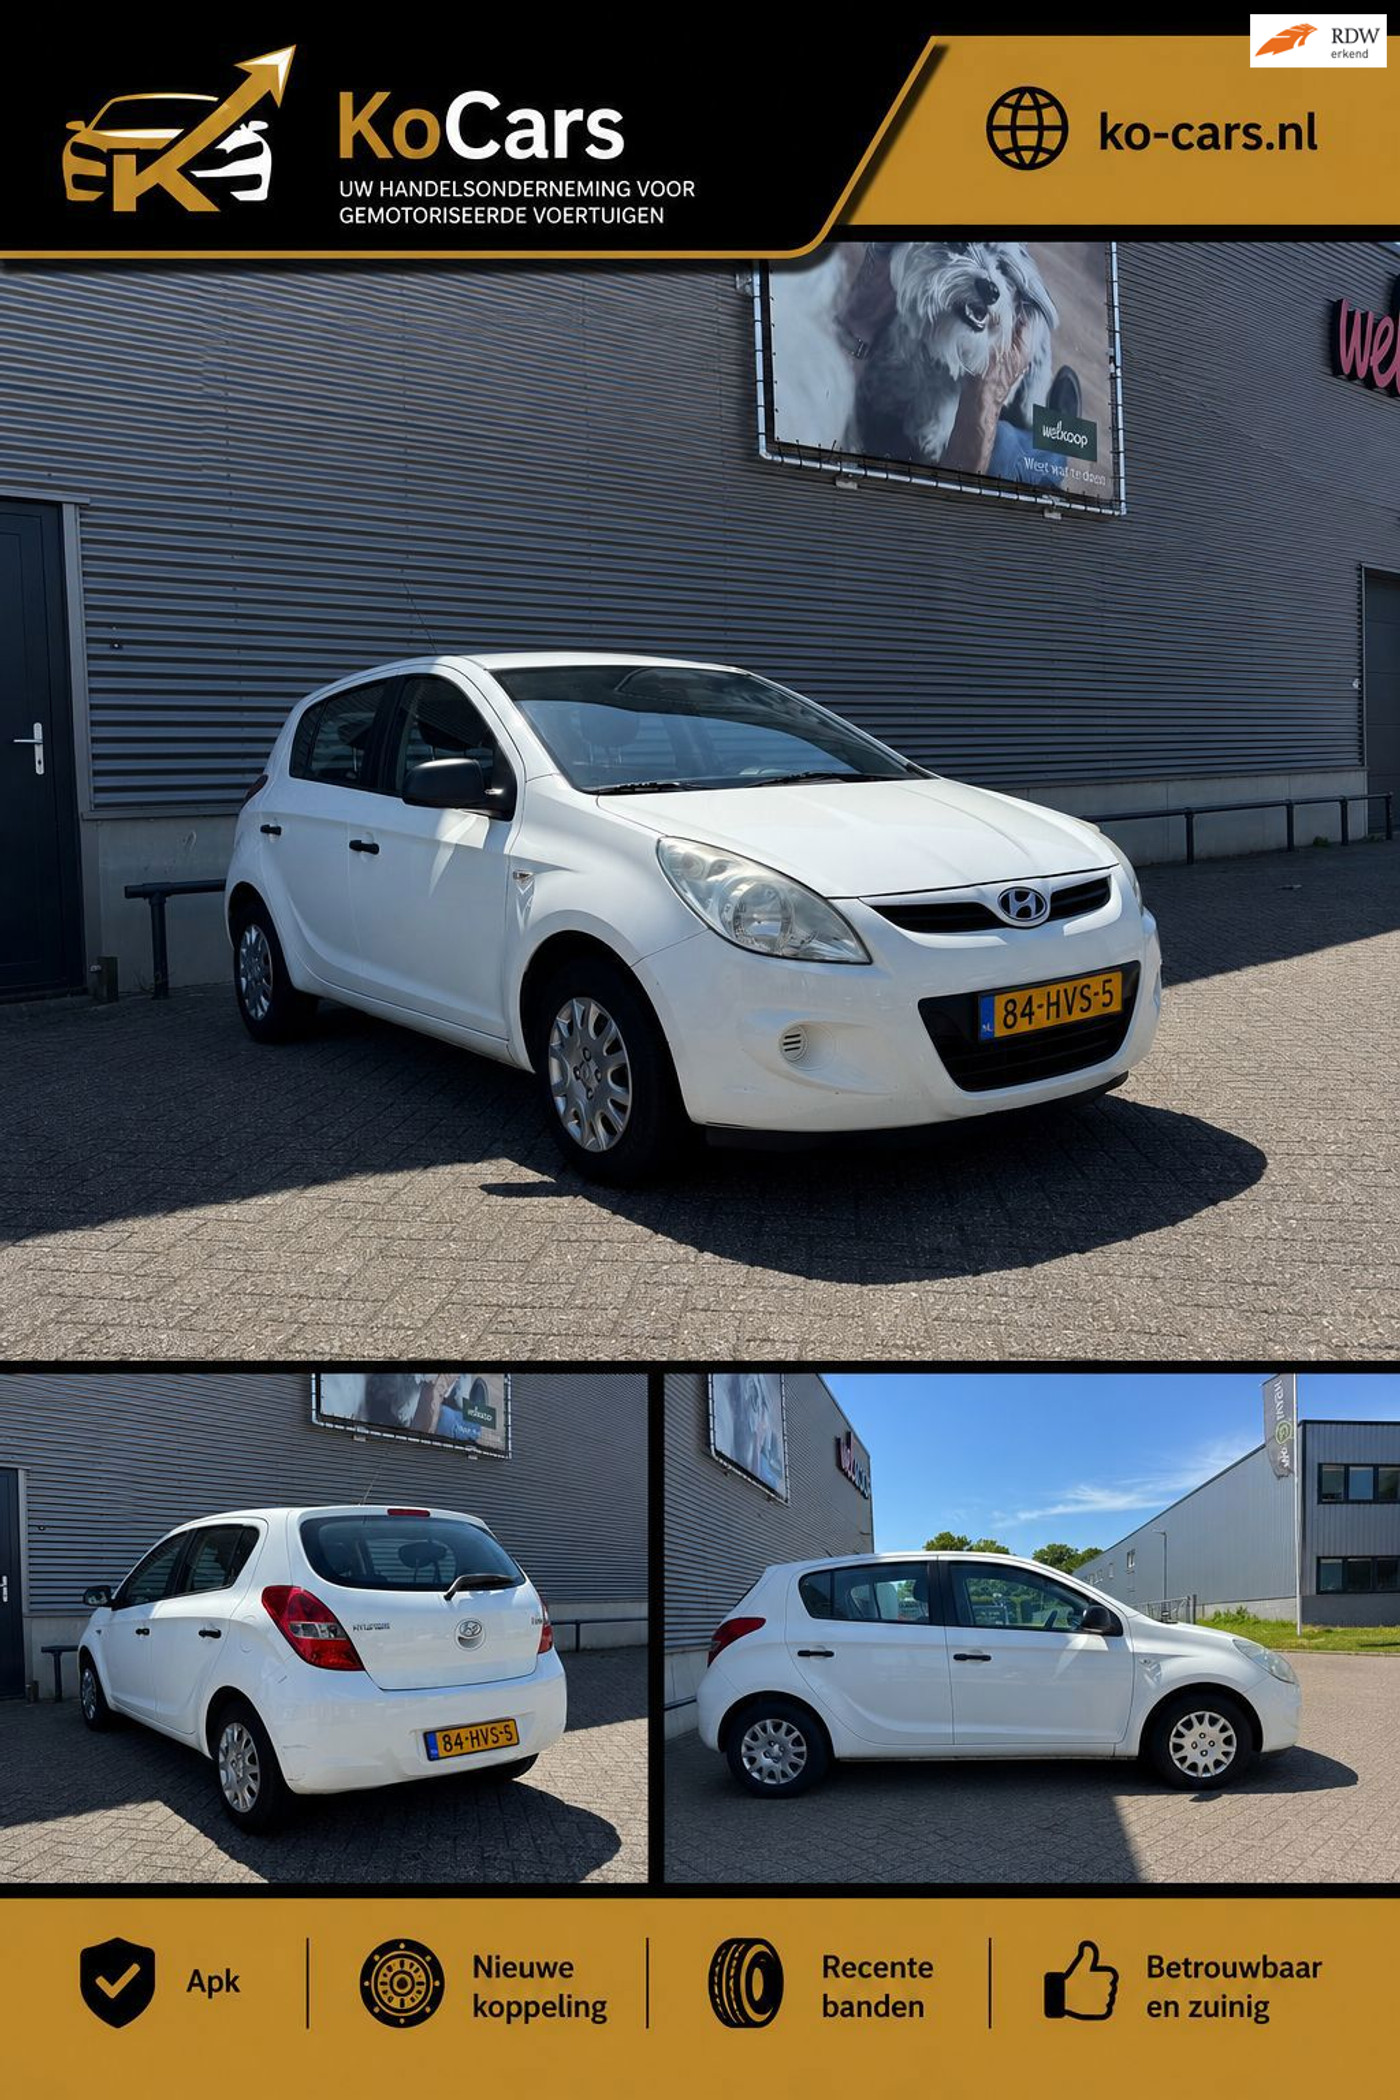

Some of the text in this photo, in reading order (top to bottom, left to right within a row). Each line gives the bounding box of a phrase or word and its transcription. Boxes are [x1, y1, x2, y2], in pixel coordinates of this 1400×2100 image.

[1340, 299, 1400, 395] we
[1003, 978, 1114, 1030] 84-HVS-5
[442, 1724, 513, 1753] 84-HVS-5
